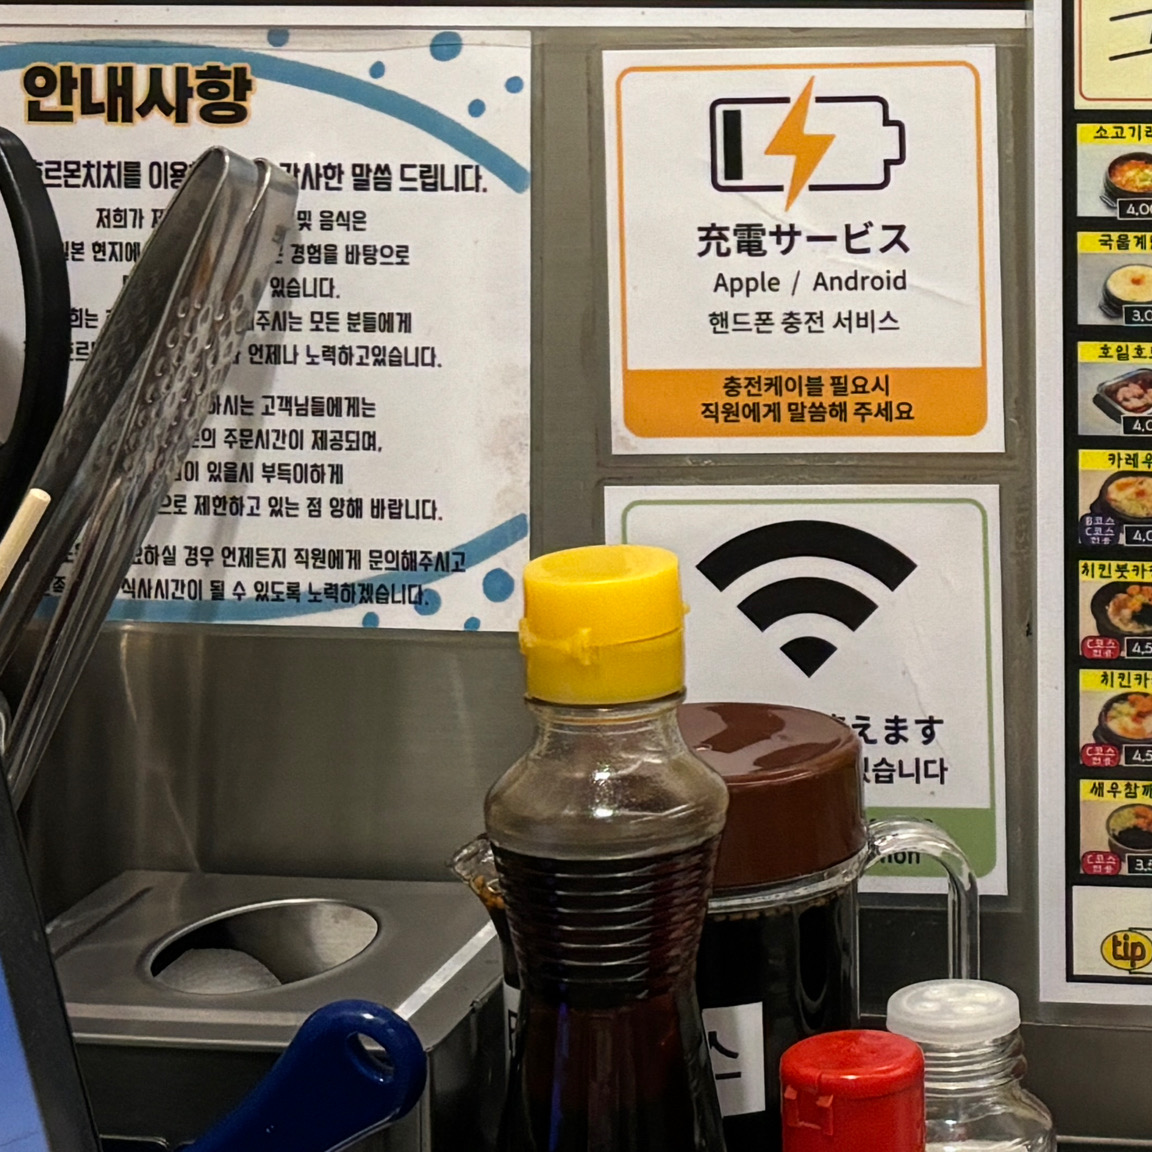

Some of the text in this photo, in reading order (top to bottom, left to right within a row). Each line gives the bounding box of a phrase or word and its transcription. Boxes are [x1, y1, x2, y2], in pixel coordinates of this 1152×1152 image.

[22, 62, 256, 126] 안내사항
[353, 164, 487, 194] 말씀 드립니다.
[697, 220, 911, 258] 充電サービス
[713, 269, 907, 298] Apple Android
[709, 309, 900, 335] 핸드폰 충전 서비스
[248, 345, 442, 369] 언제나 노력하고있습니다.
[723, 374, 891, 398] 충전케이블 필요시
[262, 395, 377, 418] 고객님들에게는
[701, 400, 915, 424] 직원에게 말씀해 주세요
[223, 430, 383, 453] 주문시간이 제공되며,
[262, 462, 344, 486] 부득이하게
[194, 495, 443, 521] 제한하고 있는 점 양해 바랍니다.
[221, 546, 466, 573] 언제든지 직원에게 문의해주시고
[1111, 933, 1146, 968] tip
